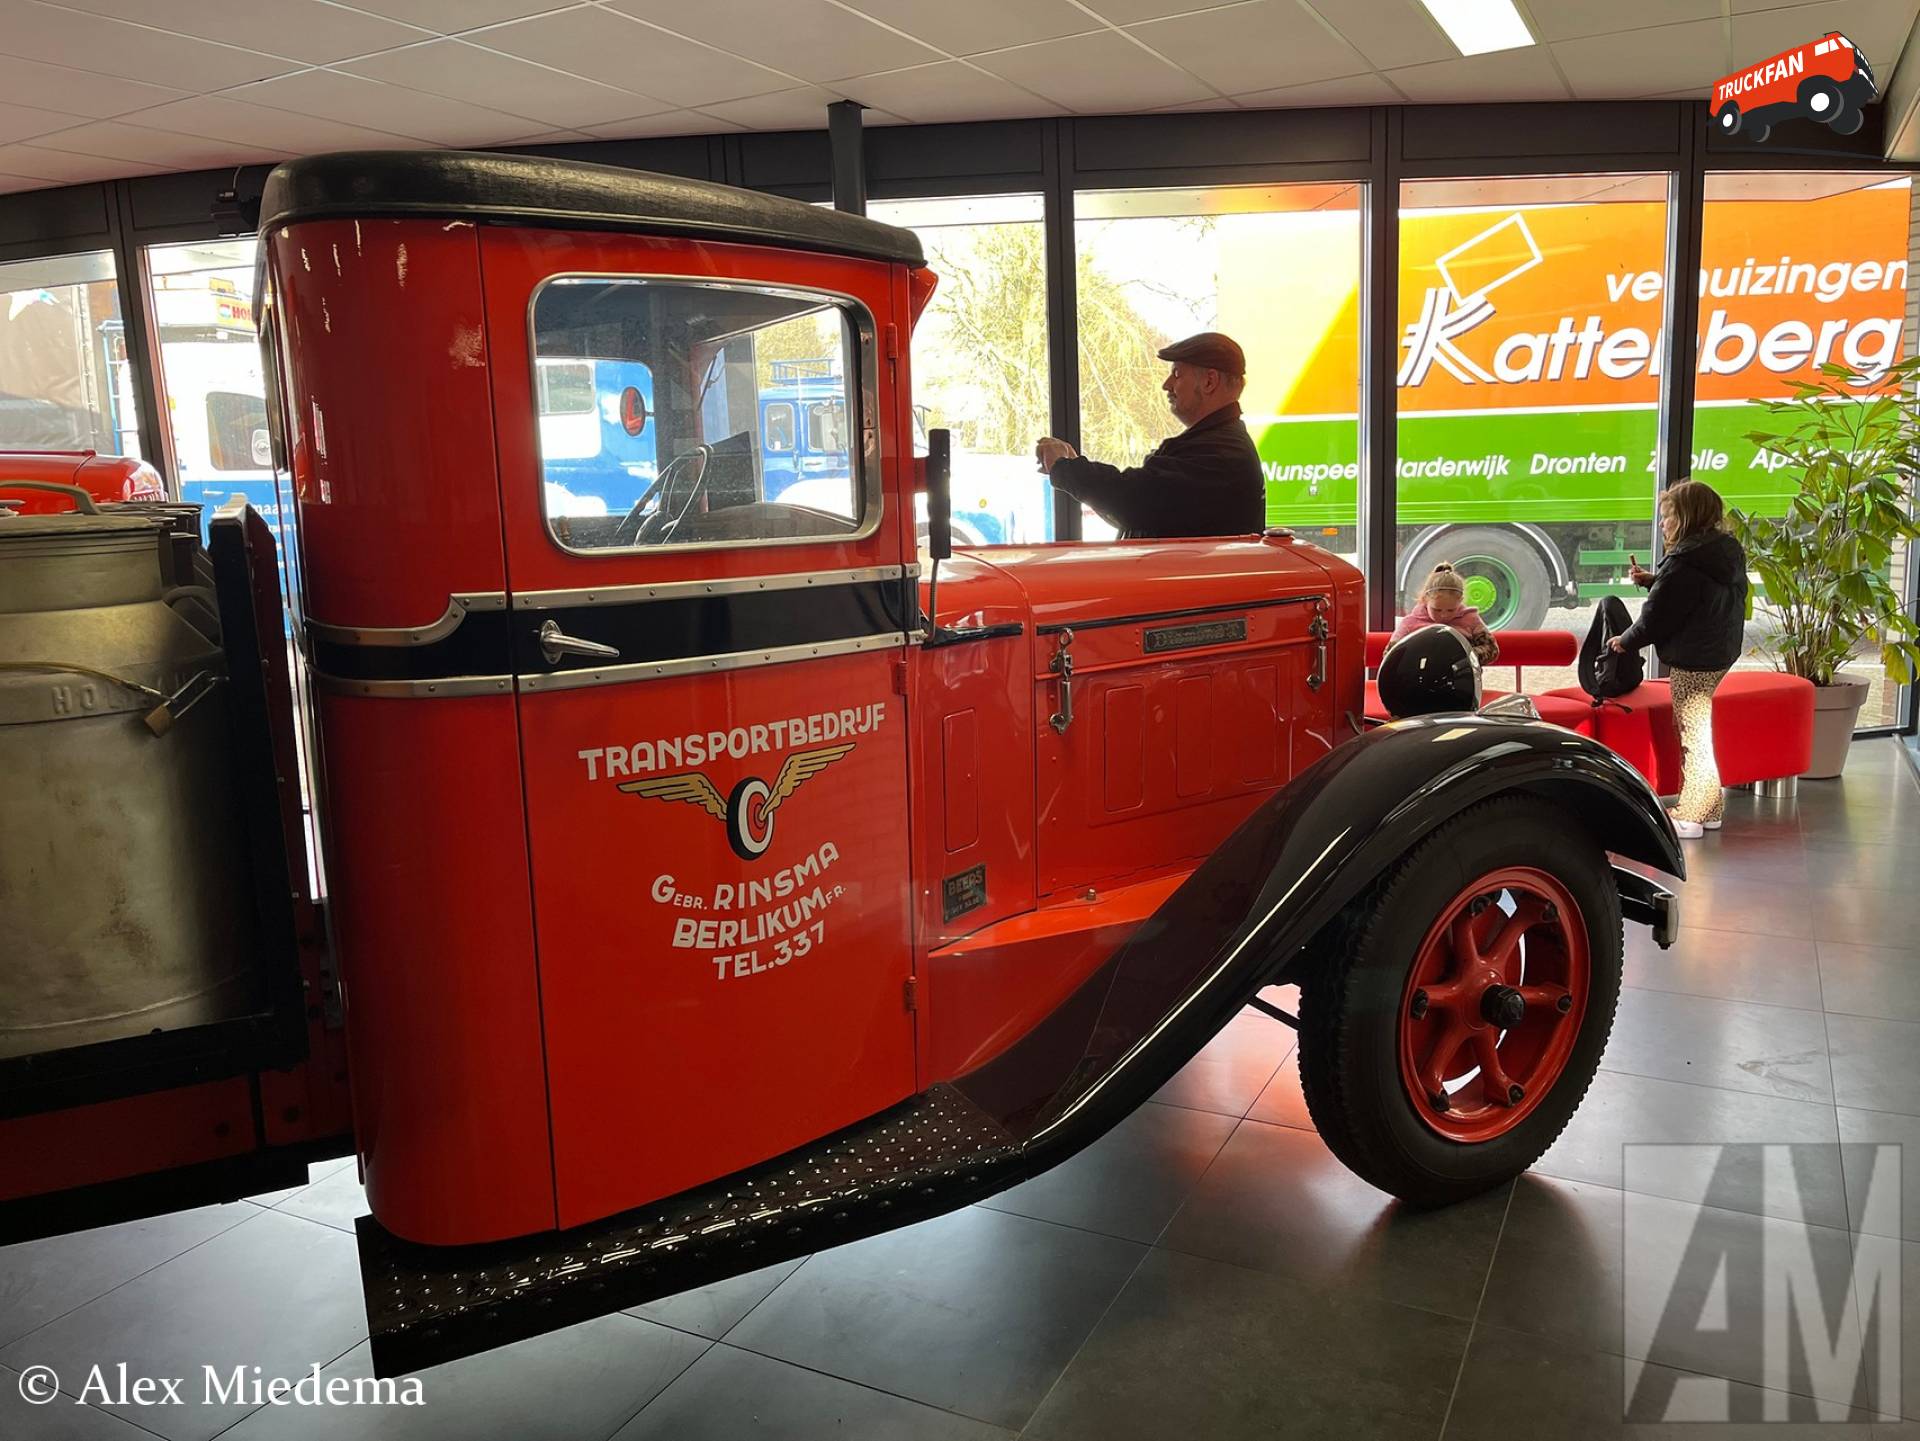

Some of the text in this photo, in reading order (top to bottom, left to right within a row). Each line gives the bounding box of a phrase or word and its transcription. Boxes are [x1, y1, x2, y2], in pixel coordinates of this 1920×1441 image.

[1605, 256, 1908, 303] veuizingen
[1262, 461, 1358, 485] Nunspee
[1529, 453, 1627, 475] Dronten
[1646, 447, 1729, 473] Zolle
[577, 702, 886, 781] TRANSPORTBEDRIJF
[713, 841, 840, 911] RINSMA
[671, 886, 828, 949] BERLIKUM
